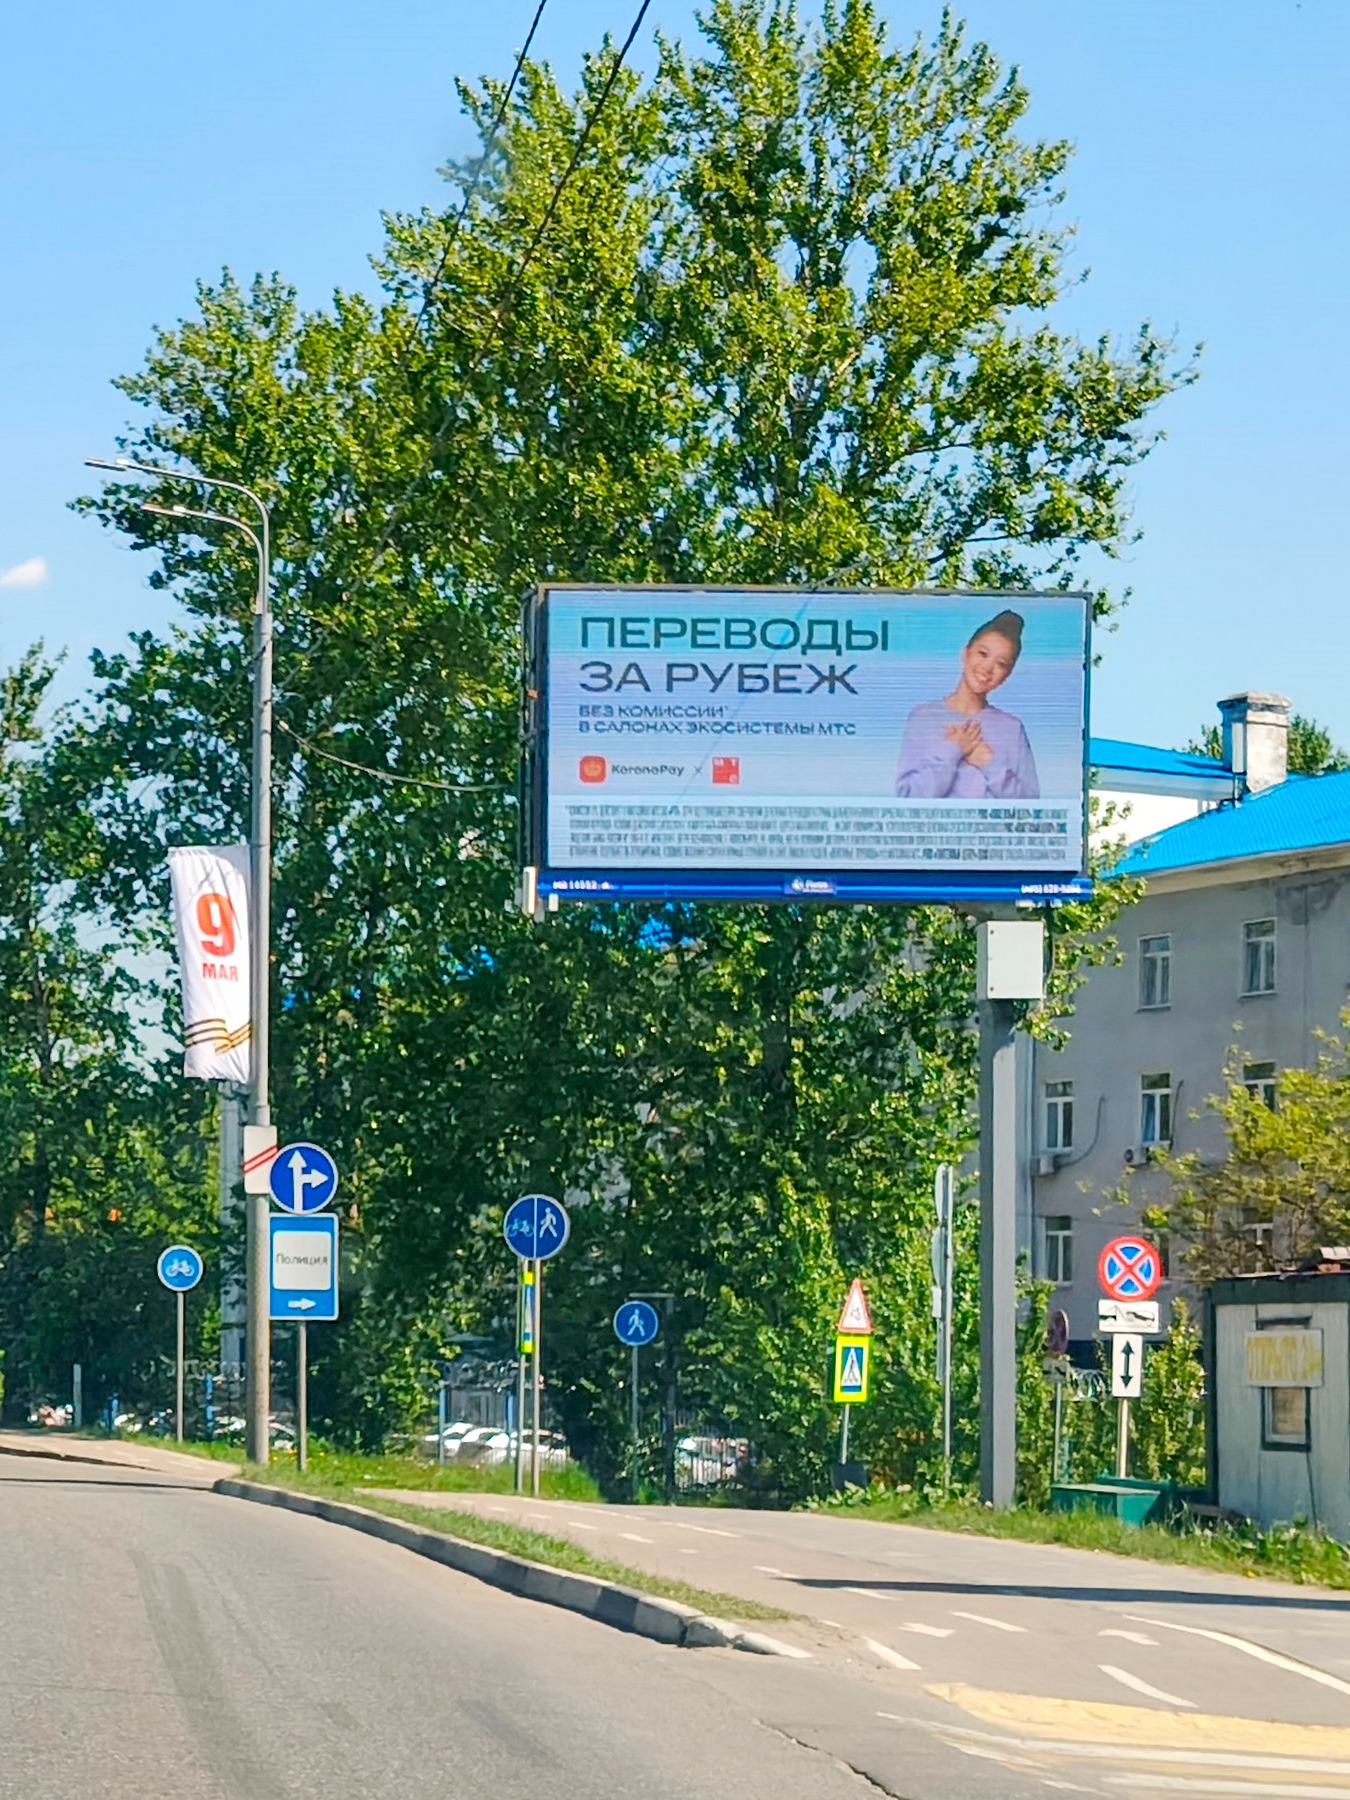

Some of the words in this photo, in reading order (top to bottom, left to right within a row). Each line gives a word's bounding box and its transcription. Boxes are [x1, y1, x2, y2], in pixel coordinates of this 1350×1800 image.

[581, 616, 888, 656] ПЕРЕВОДЫ
[579, 660, 651, 692] ЗА
[666, 662, 858, 695] РУБЕЖ
[578, 705, 614, 718] БЕЗ
[578, 721, 590, 734] В
[593, 721, 682, 734] САЛОНАХ
[686, 721, 815, 735] ЭКОСИСТЕМЫ
[818, 722, 857, 736] МТС
[196, 893, 236, 957] 9
[202, 962, 239, 982] МАЯ
[276, 1253, 328, 1266] Полиция
